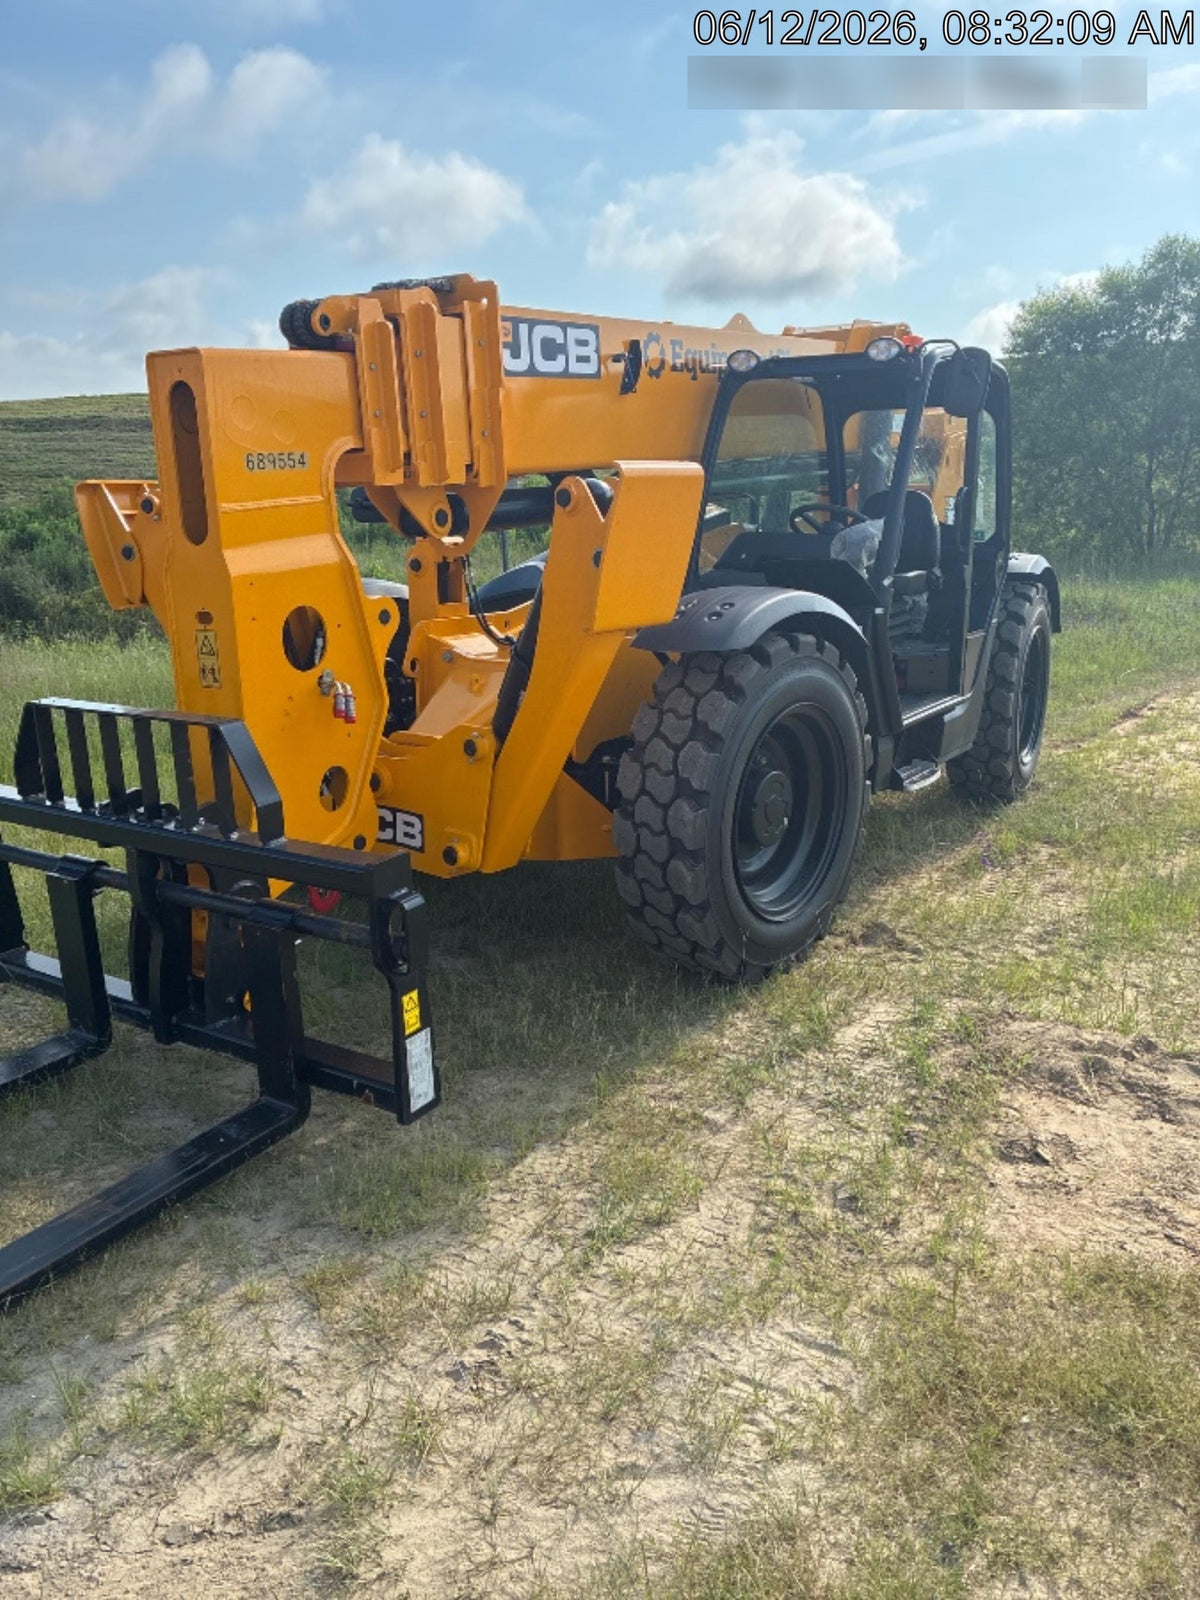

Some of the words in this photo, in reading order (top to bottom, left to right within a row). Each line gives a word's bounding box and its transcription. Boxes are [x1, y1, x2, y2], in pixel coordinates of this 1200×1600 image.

[502, 322, 599, 374] JCB
[670, 339, 728, 381] Equip
[246, 452, 306, 471] 689554
[377, 808, 422, 849] CB
